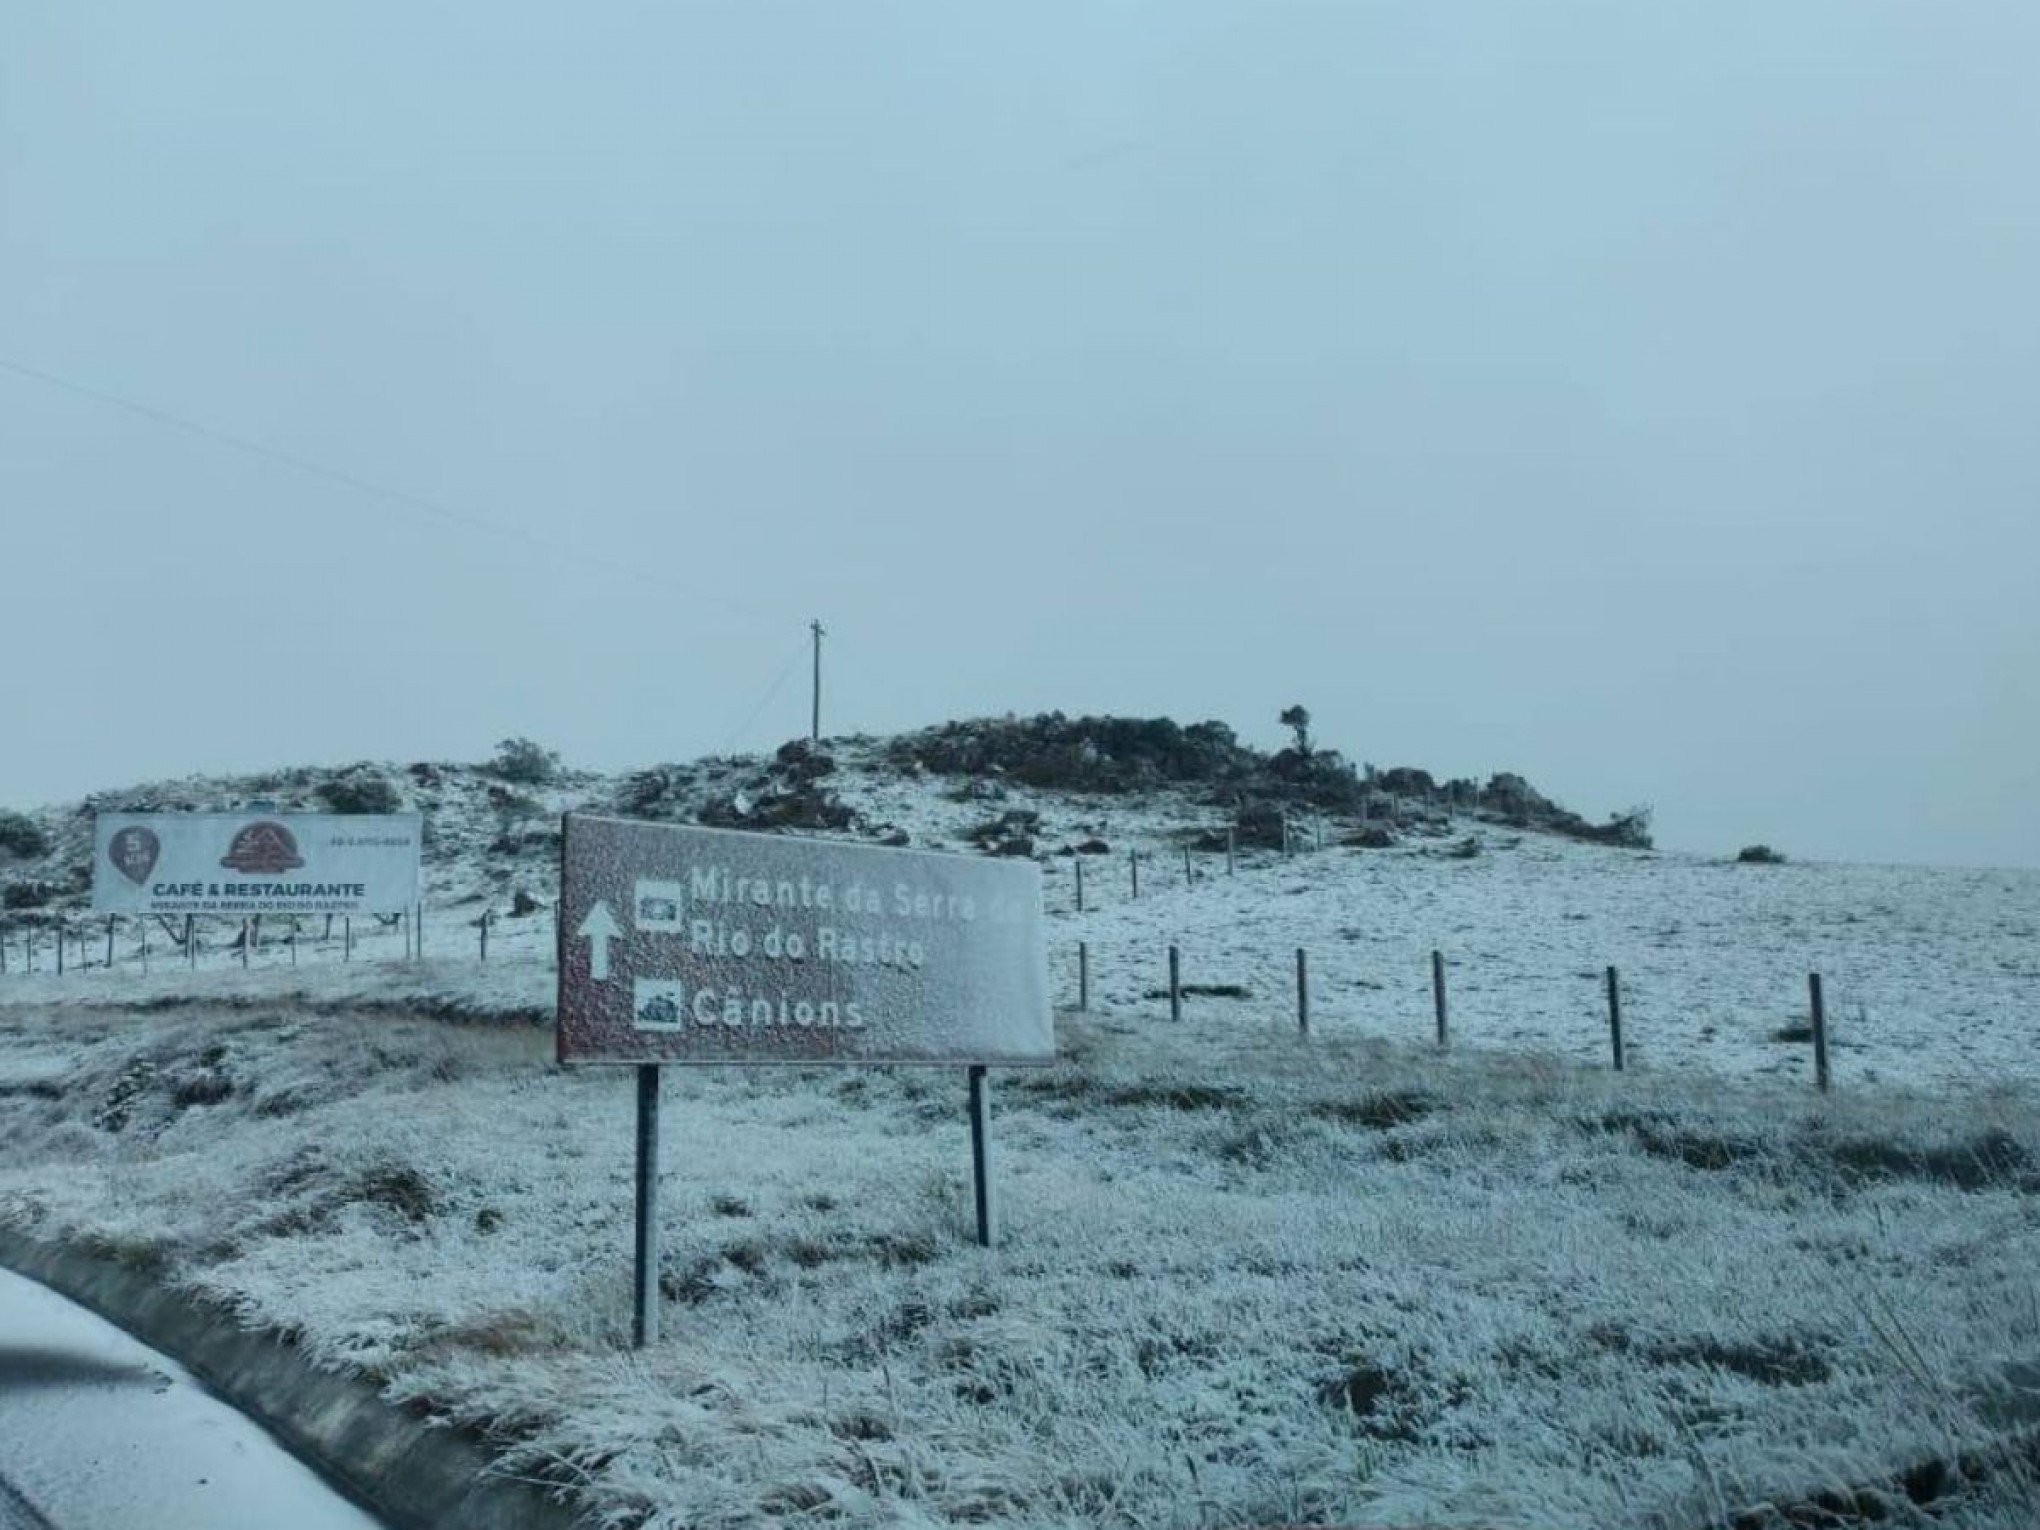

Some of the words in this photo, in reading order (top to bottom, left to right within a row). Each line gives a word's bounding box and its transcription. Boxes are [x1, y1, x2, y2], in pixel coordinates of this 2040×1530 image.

[152, 880, 203, 897] CAFÉ
[225, 883, 366, 897] RESTAURANTE
[691, 866, 833, 909] Mirante
[845, 884, 880, 914] da
[894, 883, 976, 921] Serra
[691, 919, 750, 957] Rio
[763, 925, 804, 959] do
[818, 927, 924, 966] Rastro
[692, 985, 864, 1027] Cânions
